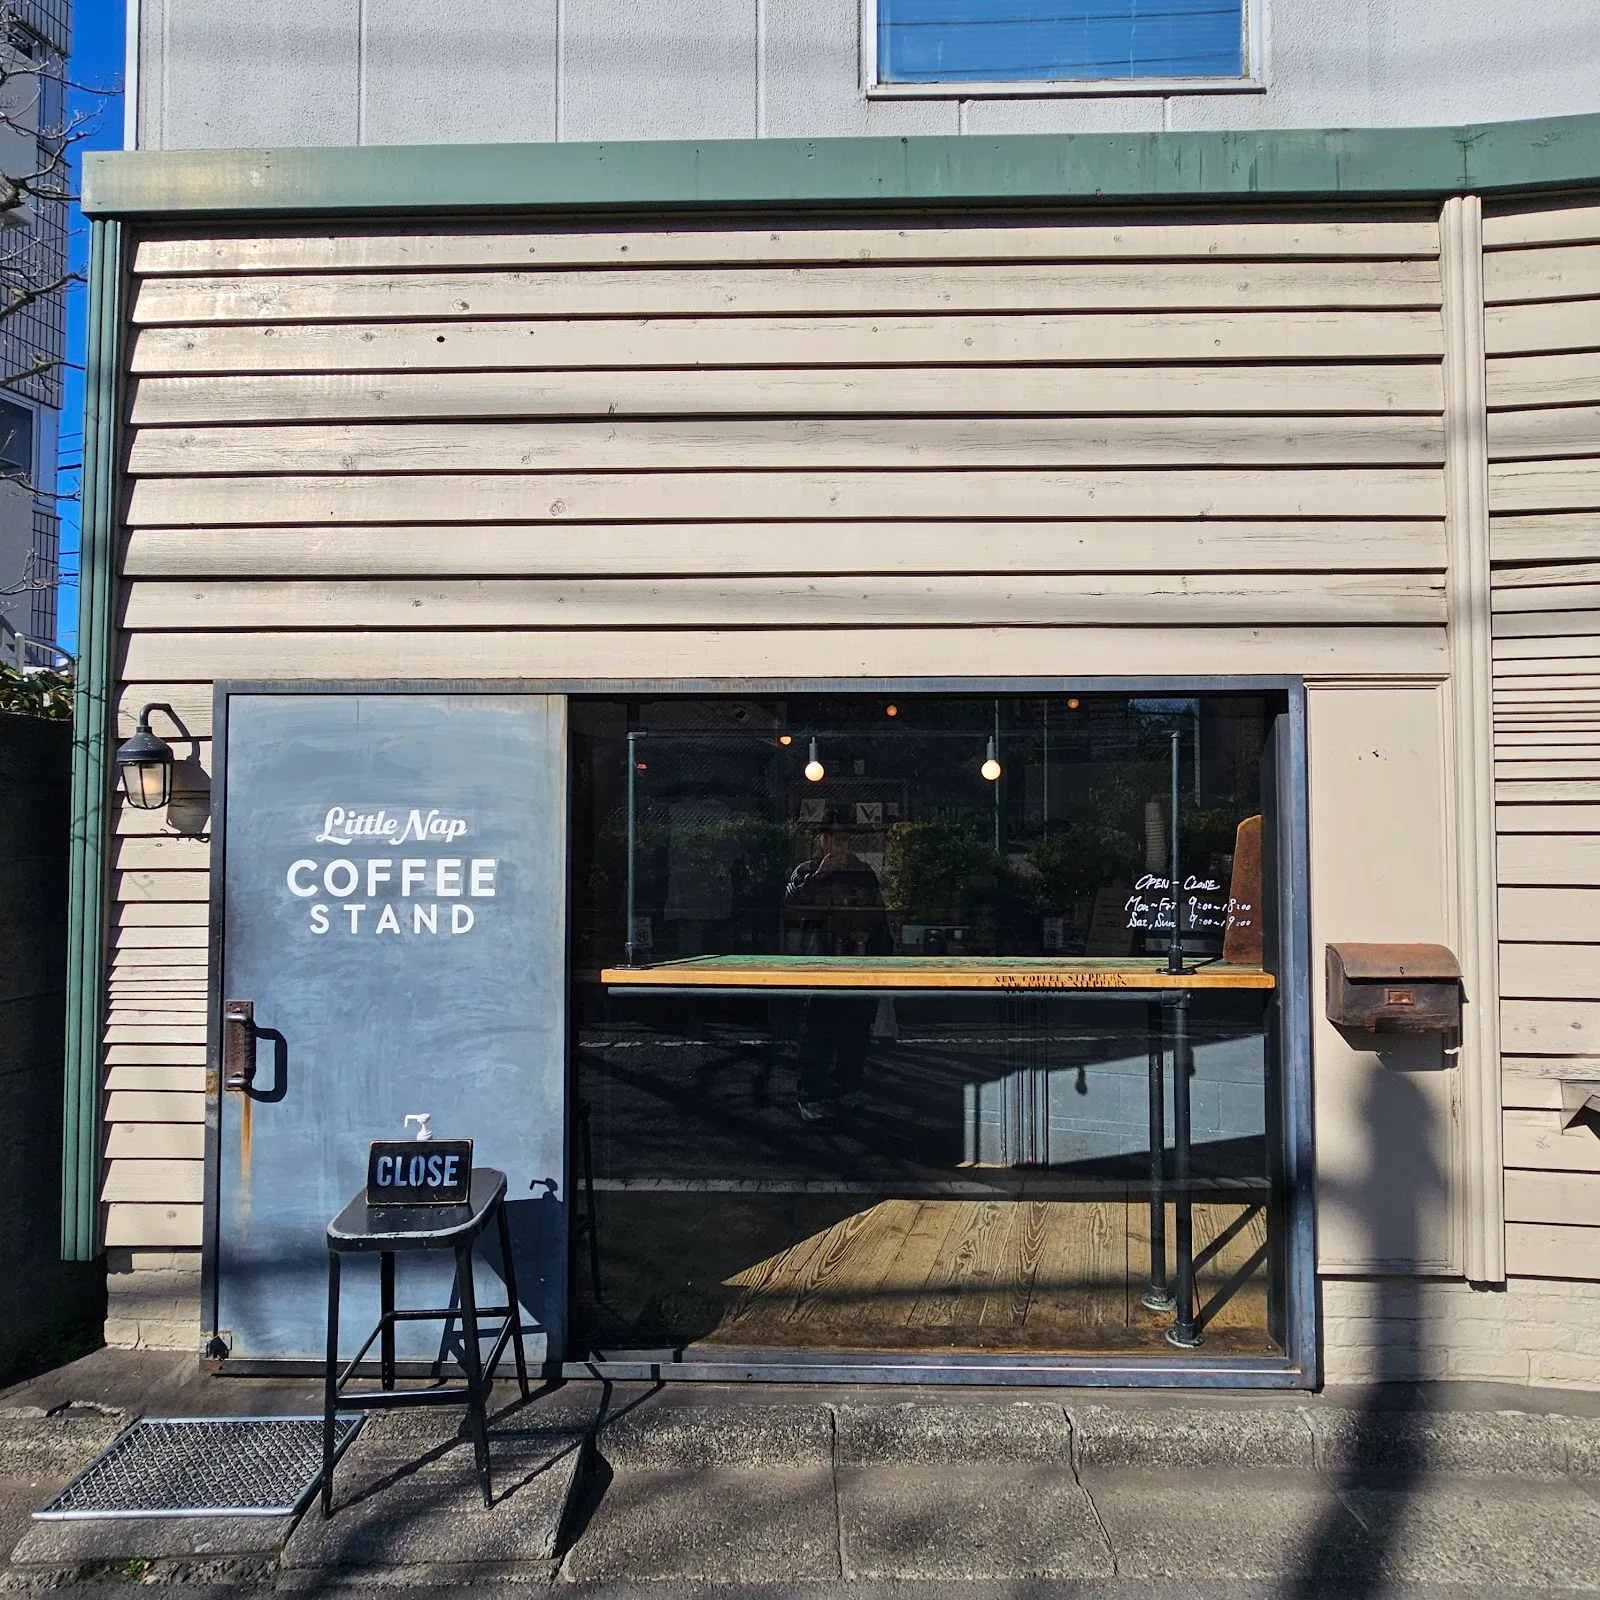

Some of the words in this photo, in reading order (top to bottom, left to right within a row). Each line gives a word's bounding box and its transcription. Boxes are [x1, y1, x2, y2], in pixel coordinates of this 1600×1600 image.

[316, 806, 398, 846] Little
[388, 809, 468, 846] Nap
[286, 858, 496, 898] COFFEE
[1135, 874, 1169, 890] OPEN
[309, 903, 475, 935] STAND
[376, 1154, 460, 1187] CLOSE
